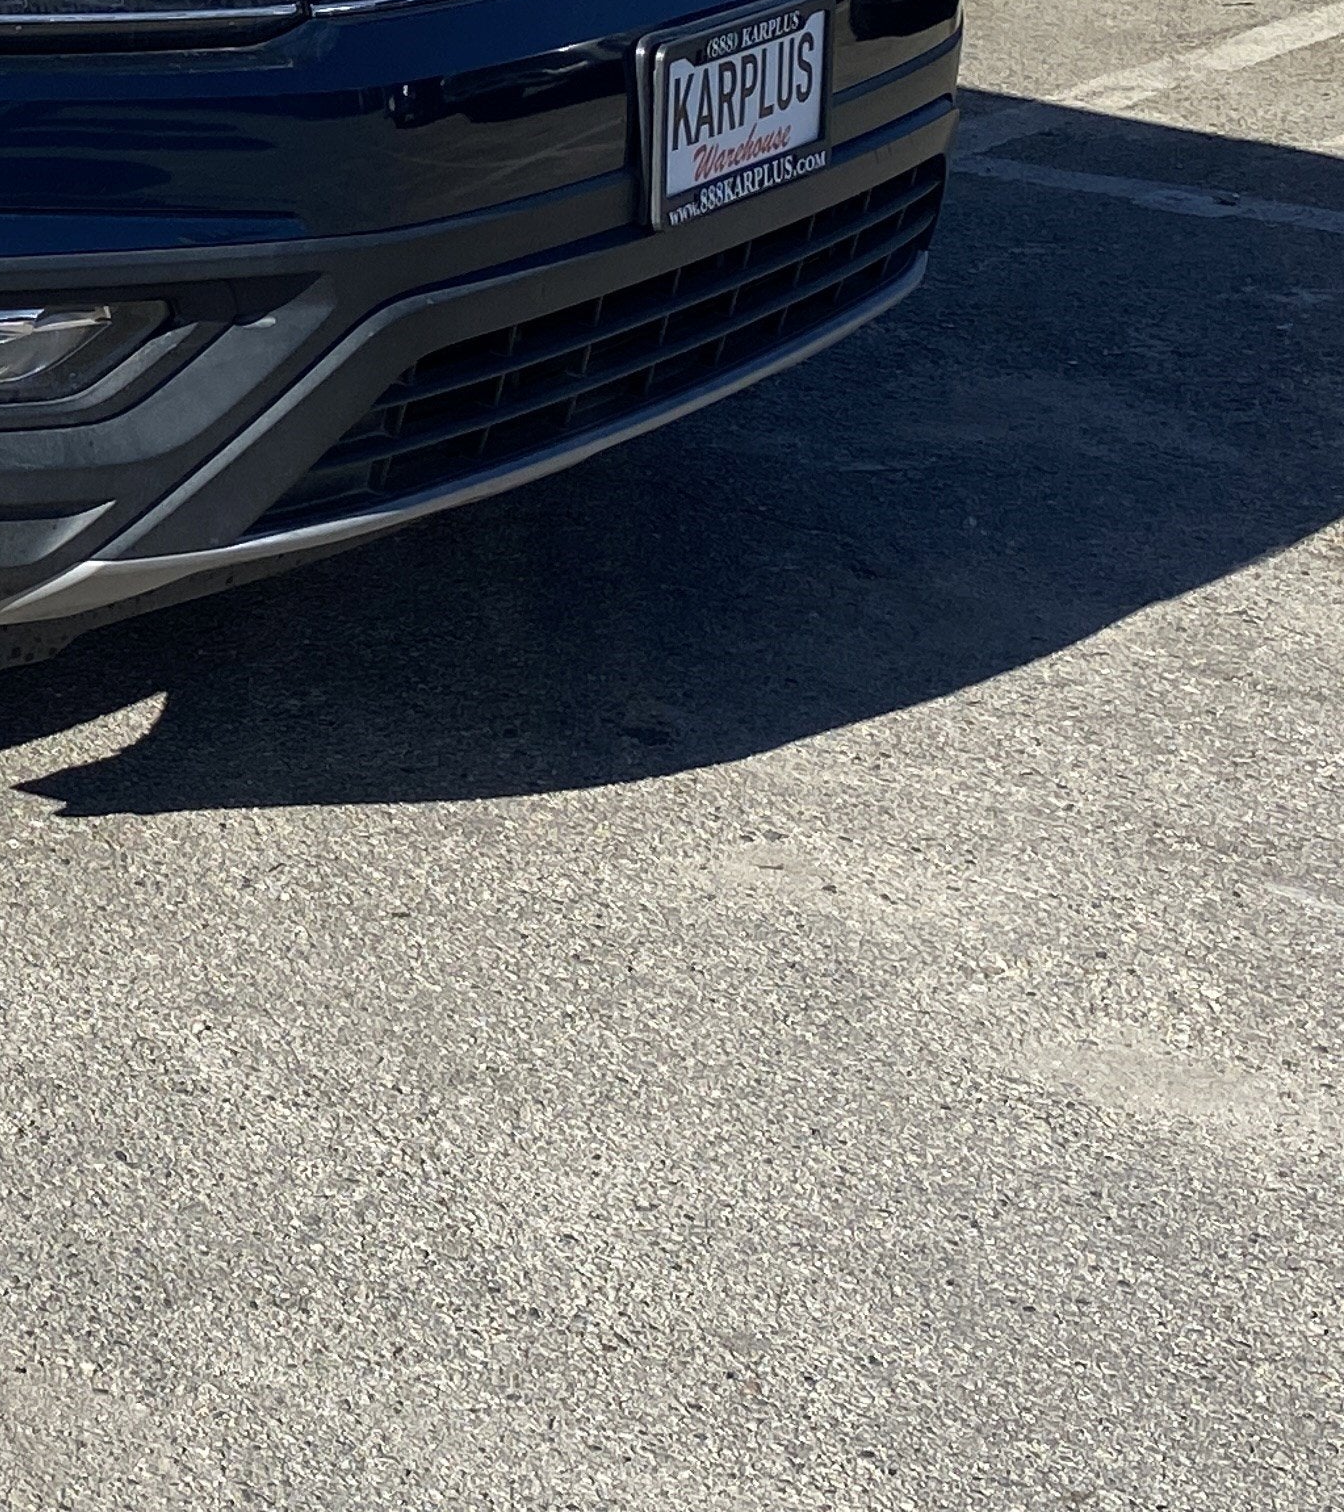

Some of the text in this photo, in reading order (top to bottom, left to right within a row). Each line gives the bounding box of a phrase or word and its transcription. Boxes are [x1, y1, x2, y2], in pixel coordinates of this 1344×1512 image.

[741, 10, 800, 48] KARPLUS
[672, 31, 815, 152] KARPLUS
[693, 122, 792, 182] Warehouse
